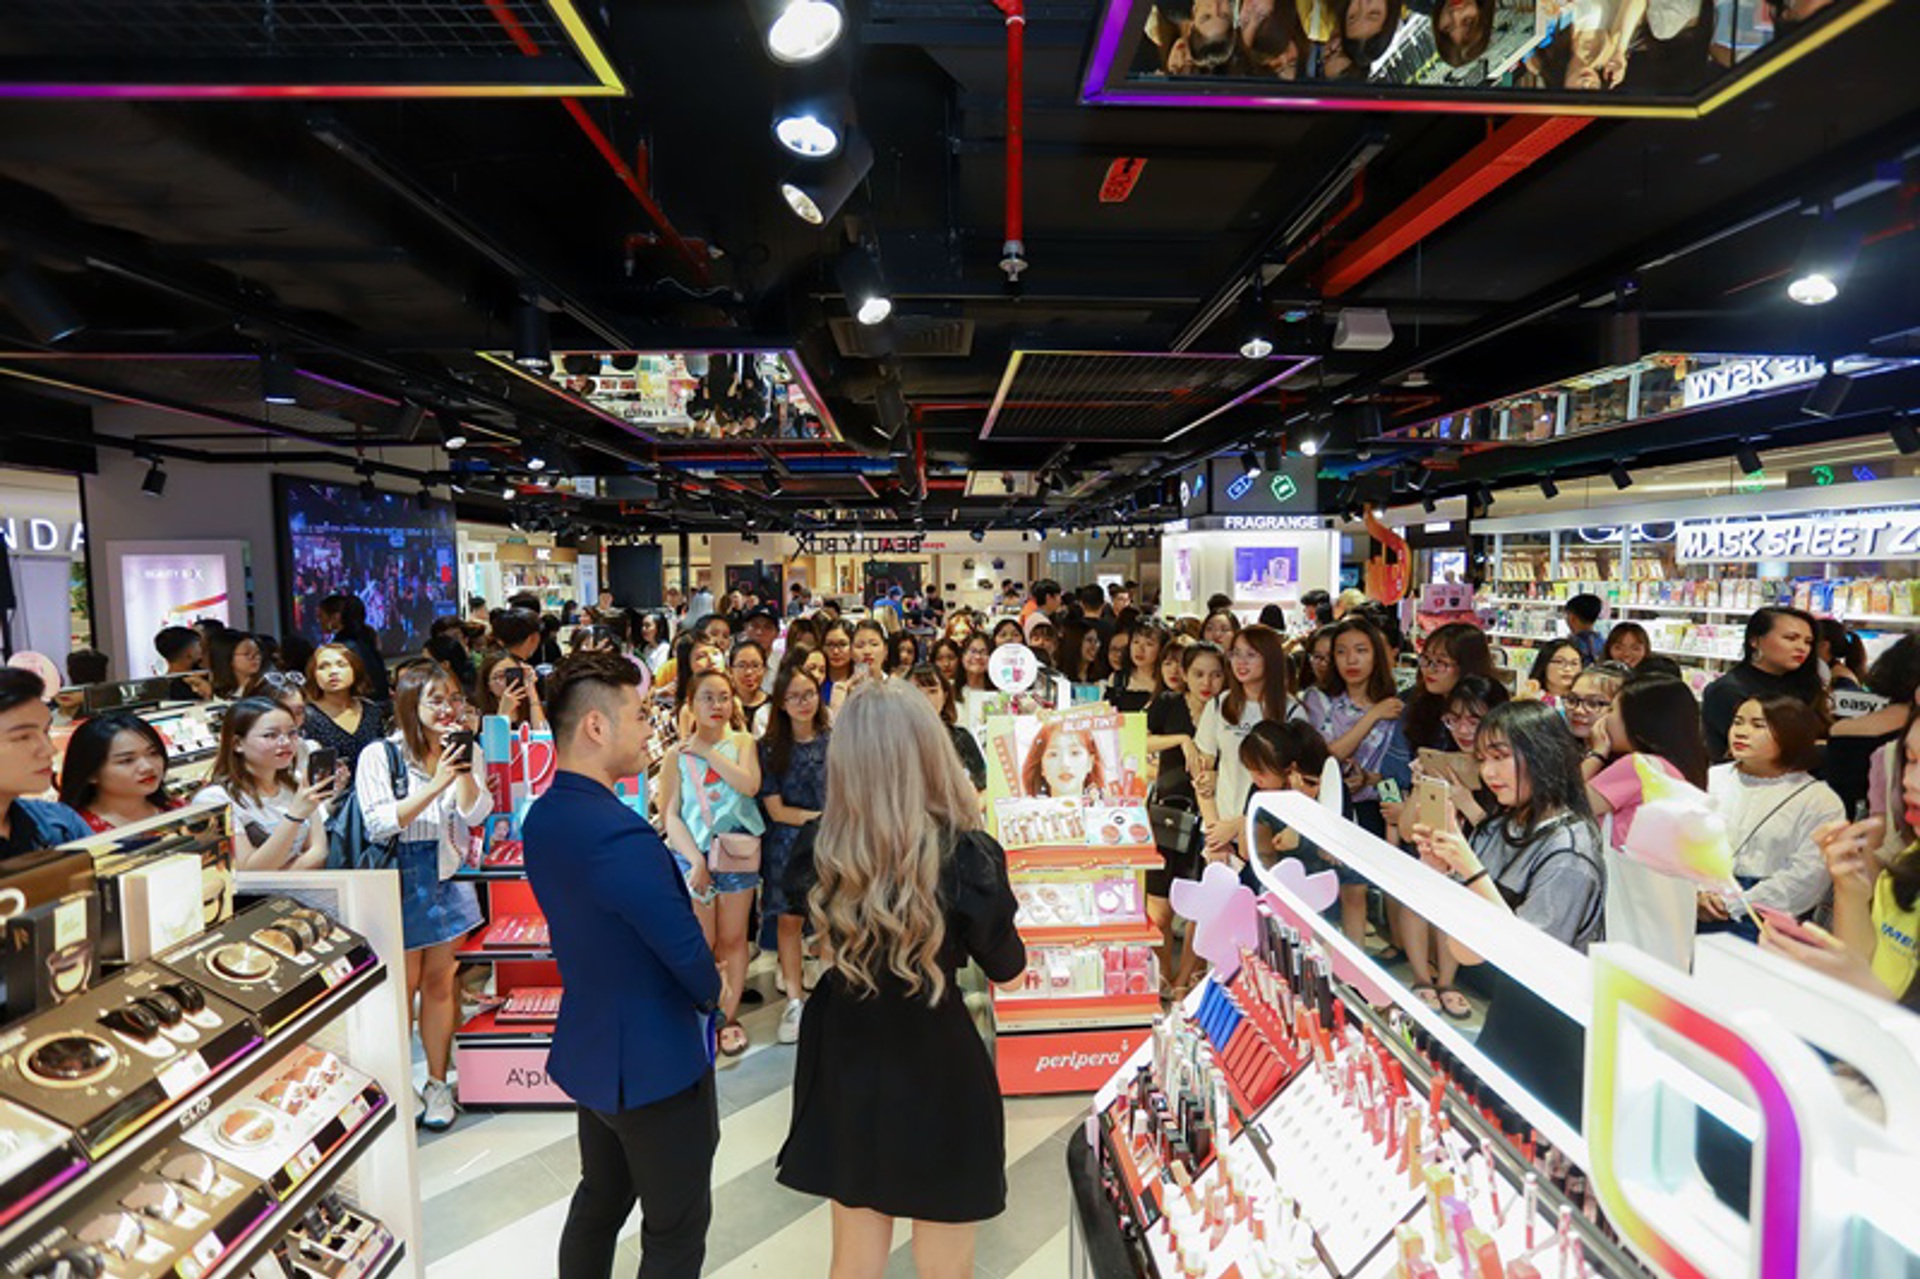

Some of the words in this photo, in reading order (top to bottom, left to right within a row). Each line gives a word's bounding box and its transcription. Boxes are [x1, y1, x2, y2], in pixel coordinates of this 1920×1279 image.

[1684, 528, 1766, 560] MASK
[1768, 520, 1892, 558] SHEET
[1839, 698, 1878, 713] easy
[1035, 1049, 1120, 1073] peripera
